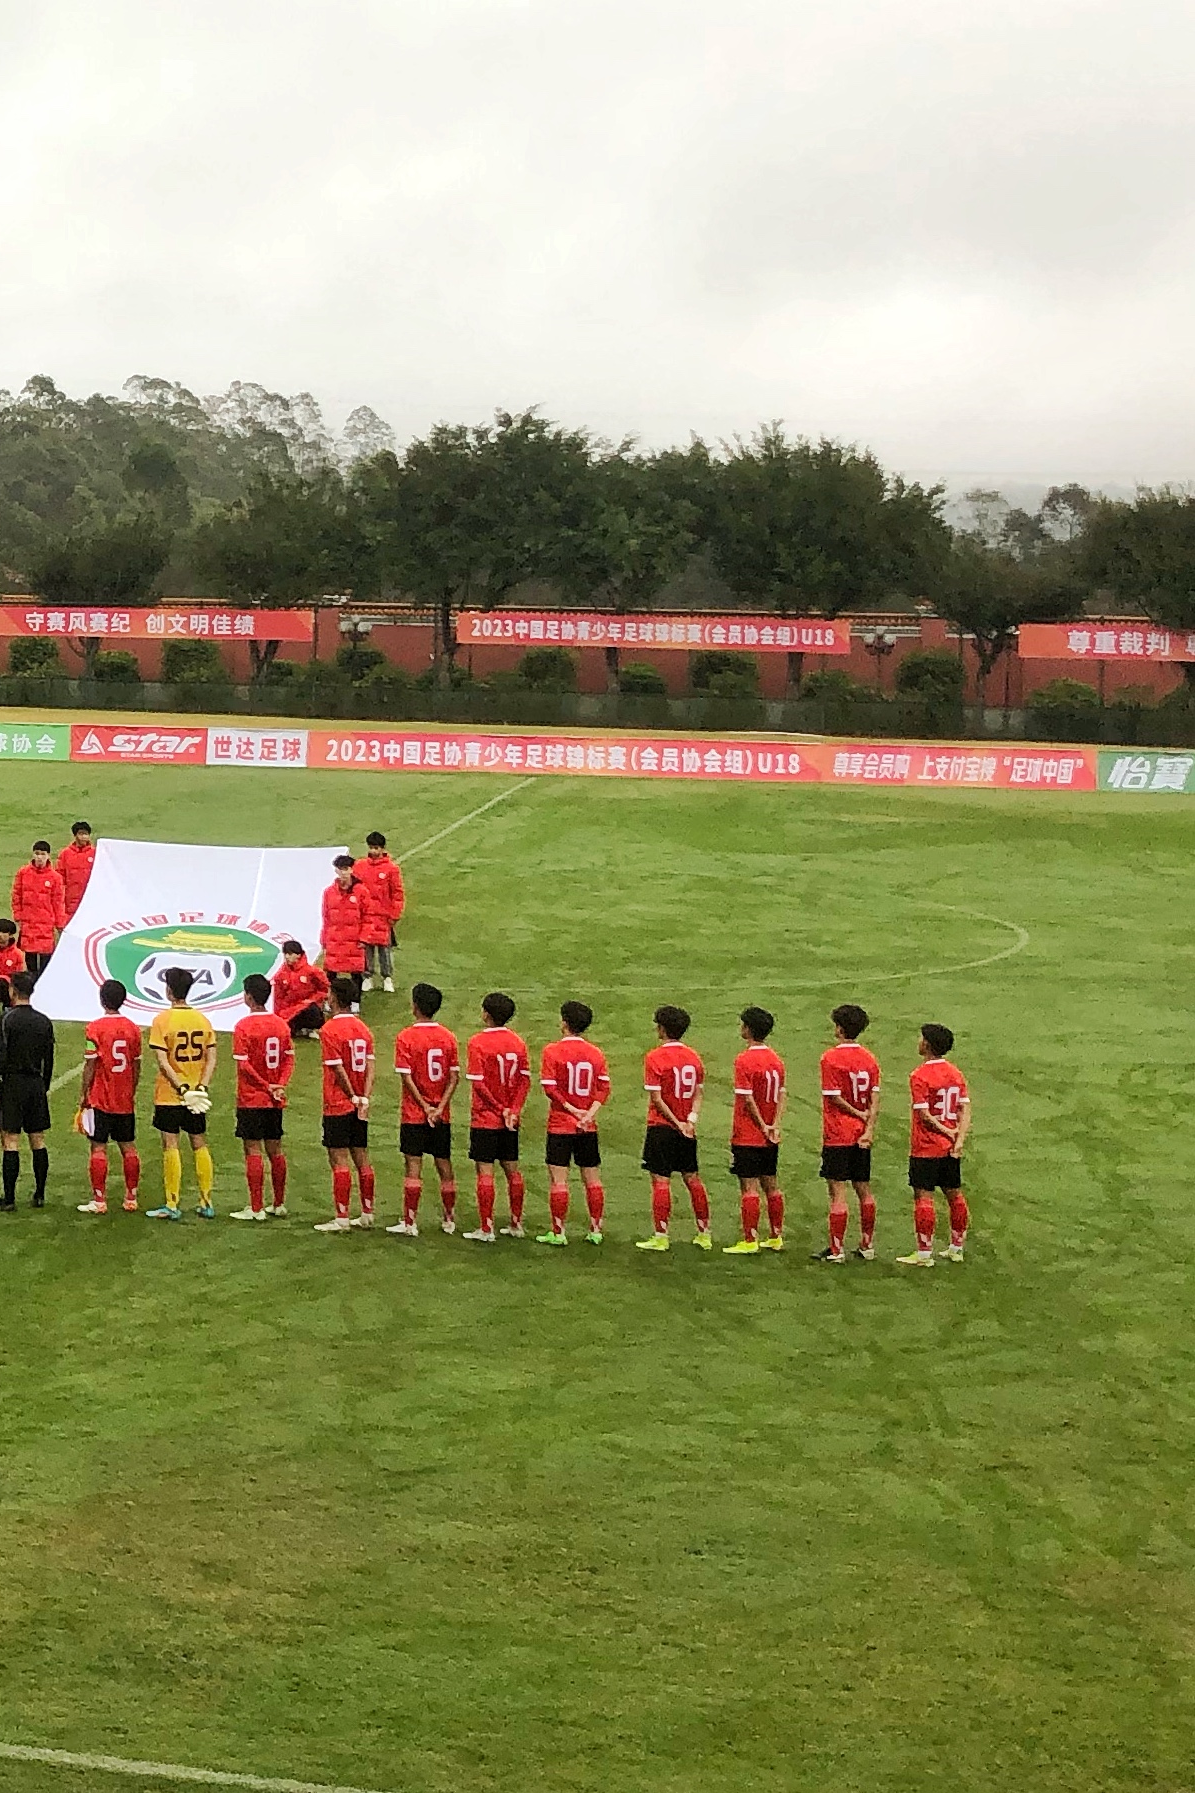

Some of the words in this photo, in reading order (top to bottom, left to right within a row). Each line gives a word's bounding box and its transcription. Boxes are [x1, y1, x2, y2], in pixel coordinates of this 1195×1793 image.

[25, 612, 131, 633] 守赛风赛纪
[145, 614, 255, 635] 创文明佳绩
[1067, 630, 1170, 656] 尊重裁判
[213, 735, 301, 761] 世达足球
[111, 1040, 127, 1072] 5
[174, 1031, 204, 1062] 25
[265, 1037, 280, 1069] 8
[348, 1038, 367, 1072] 18
[427, 1049, 443, 1082] 6
[566, 1061, 593, 1097] 10
[673, 1065, 697, 1099] 19
[765, 1070, 779, 1104] 11
